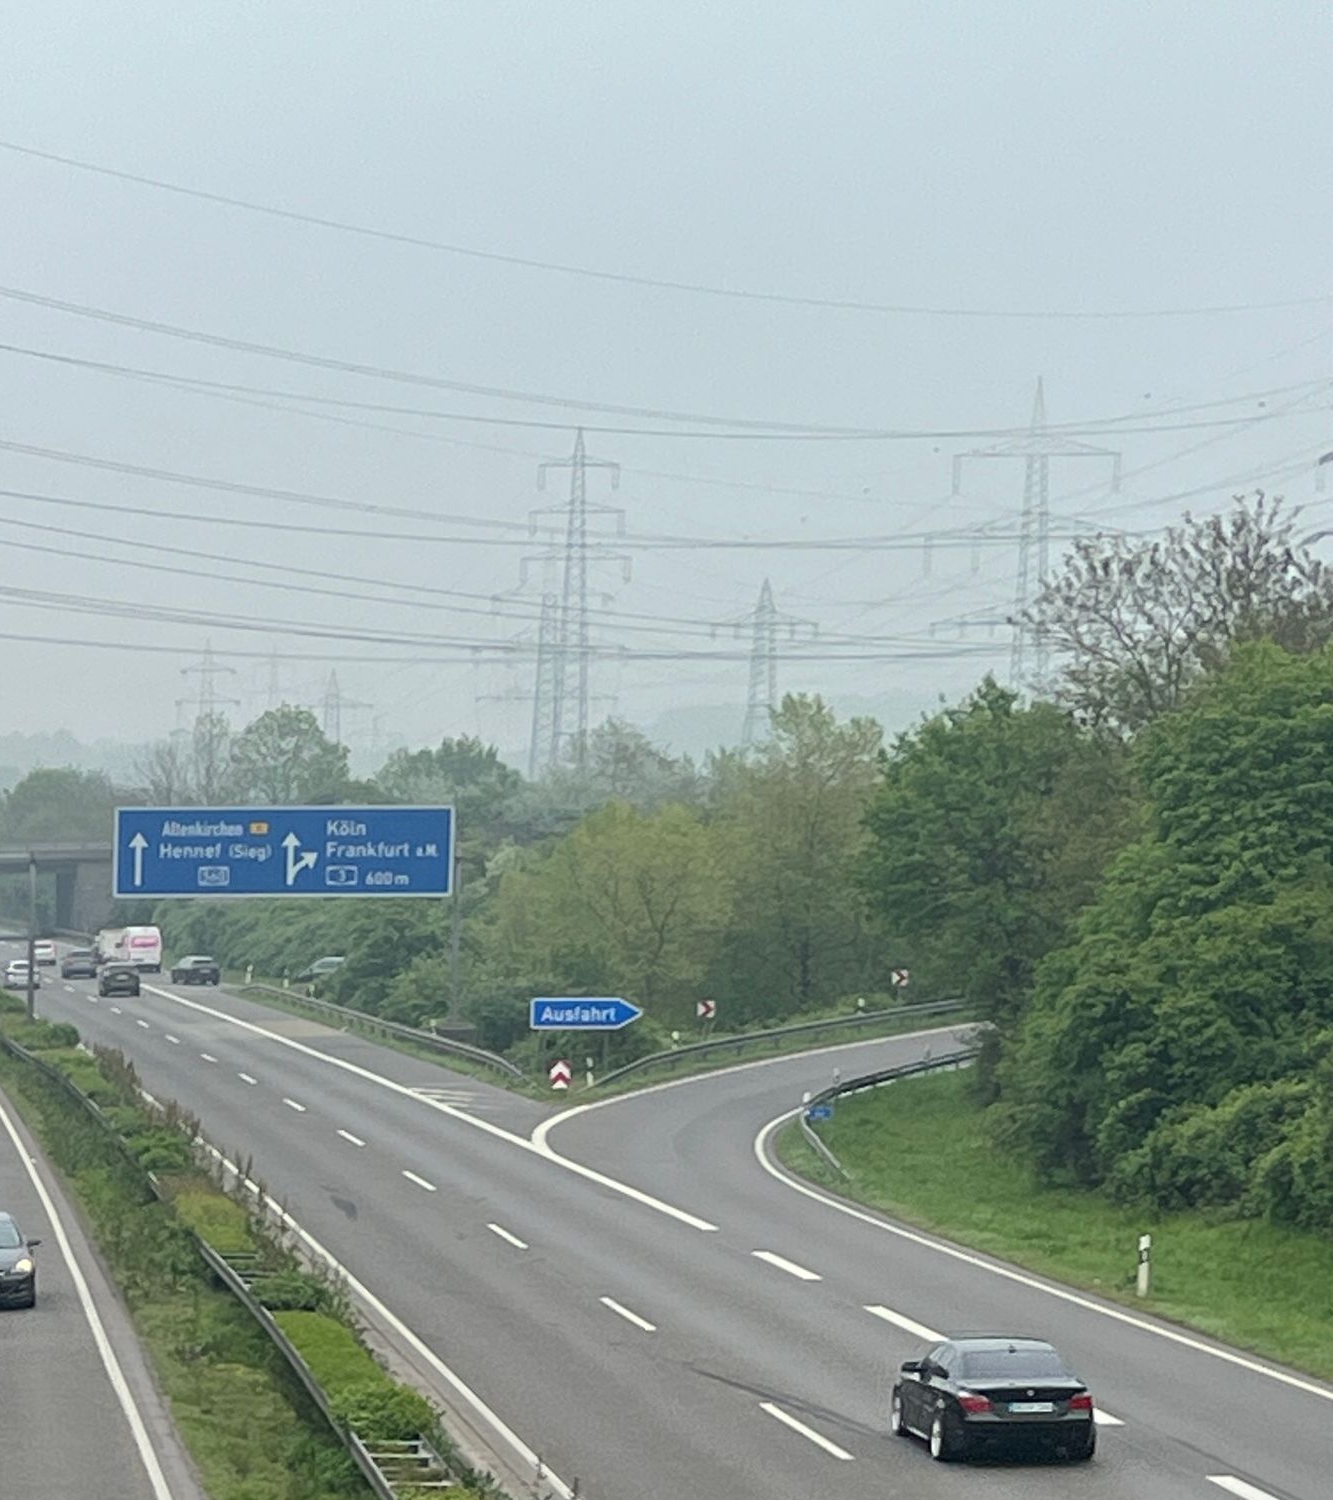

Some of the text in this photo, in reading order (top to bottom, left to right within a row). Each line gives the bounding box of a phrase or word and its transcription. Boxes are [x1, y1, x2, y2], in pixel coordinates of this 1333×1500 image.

[326, 819, 367, 836] Köln
[159, 842, 272, 862] Hennef (Sieg)
[325, 841, 410, 858] Frankfurt
[365, 871, 410, 886] 600 m
[540, 1006, 616, 1022] Ausfahrt
